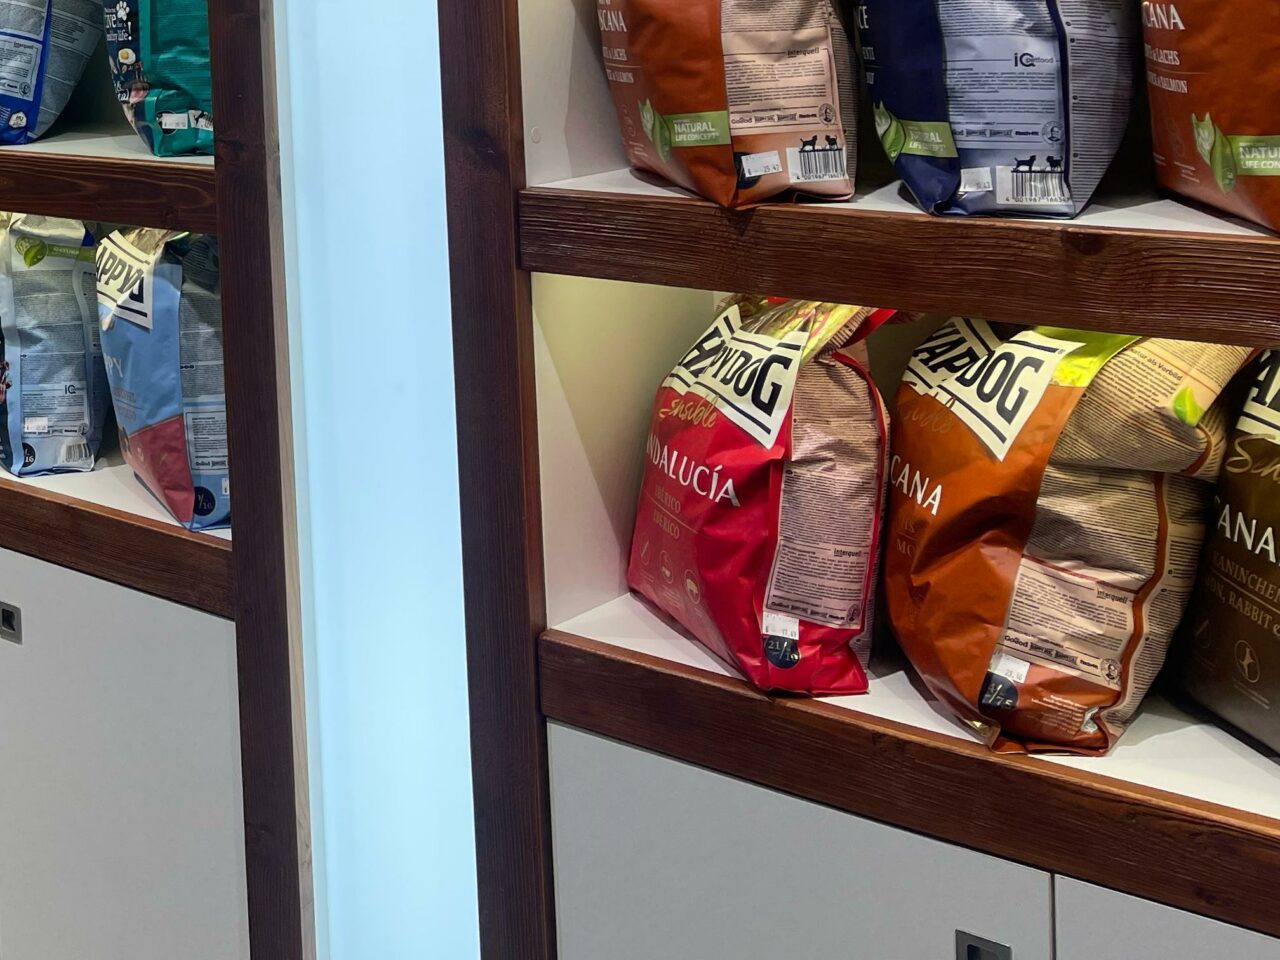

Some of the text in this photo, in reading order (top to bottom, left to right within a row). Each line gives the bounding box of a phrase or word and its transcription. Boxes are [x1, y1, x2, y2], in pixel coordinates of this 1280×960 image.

[598, 11, 628, 33] SCANA
[1142, 1, 1186, 30] CANA
[674, 120, 716, 133] NATURAL
[675, 133, 688, 142] LIFE
[1240, 147, 1280, 160] NATU
[1241, 160, 1260, 170] LIFE
[96, 245, 144, 293] APPY
[1158, 362, 1183, 381] Vorbild
[723, 351, 793, 418] DOG
[955, 351, 1044, 425] DOG
[891, 454, 943, 516] CANA
[1229, 591, 1273, 630] RABBIT
